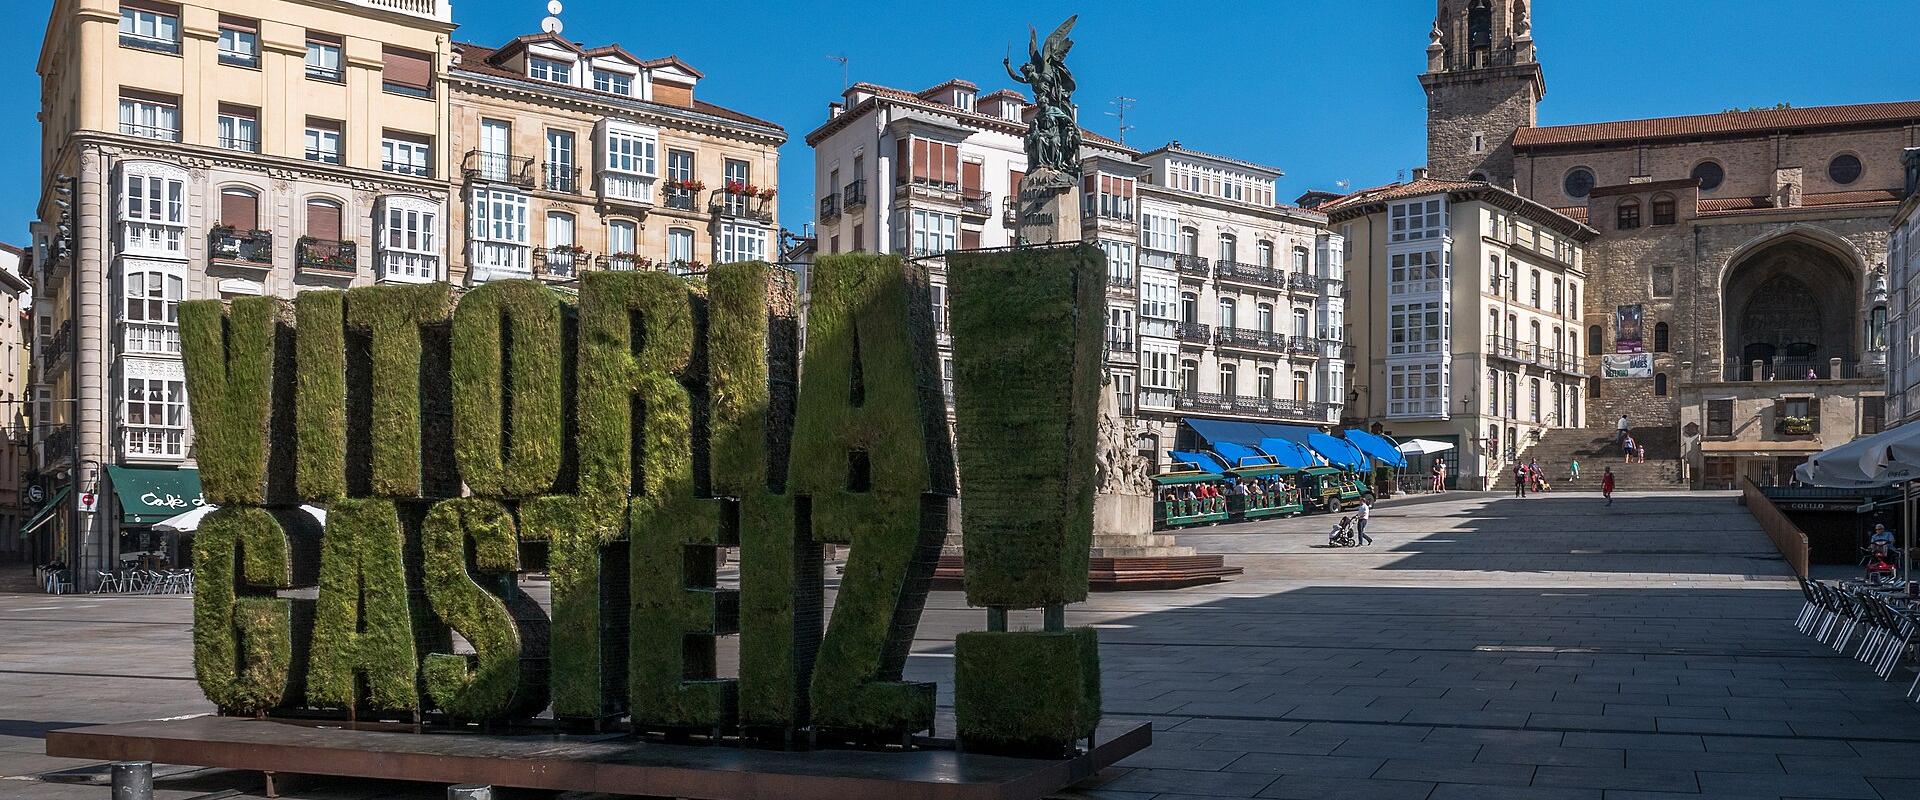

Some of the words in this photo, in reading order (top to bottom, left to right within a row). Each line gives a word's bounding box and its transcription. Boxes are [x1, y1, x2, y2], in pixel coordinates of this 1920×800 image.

[140, 492, 188, 510] Café
[178, 253, 952, 510] VITORIA
[193, 492, 938, 736] GASTEIZ
